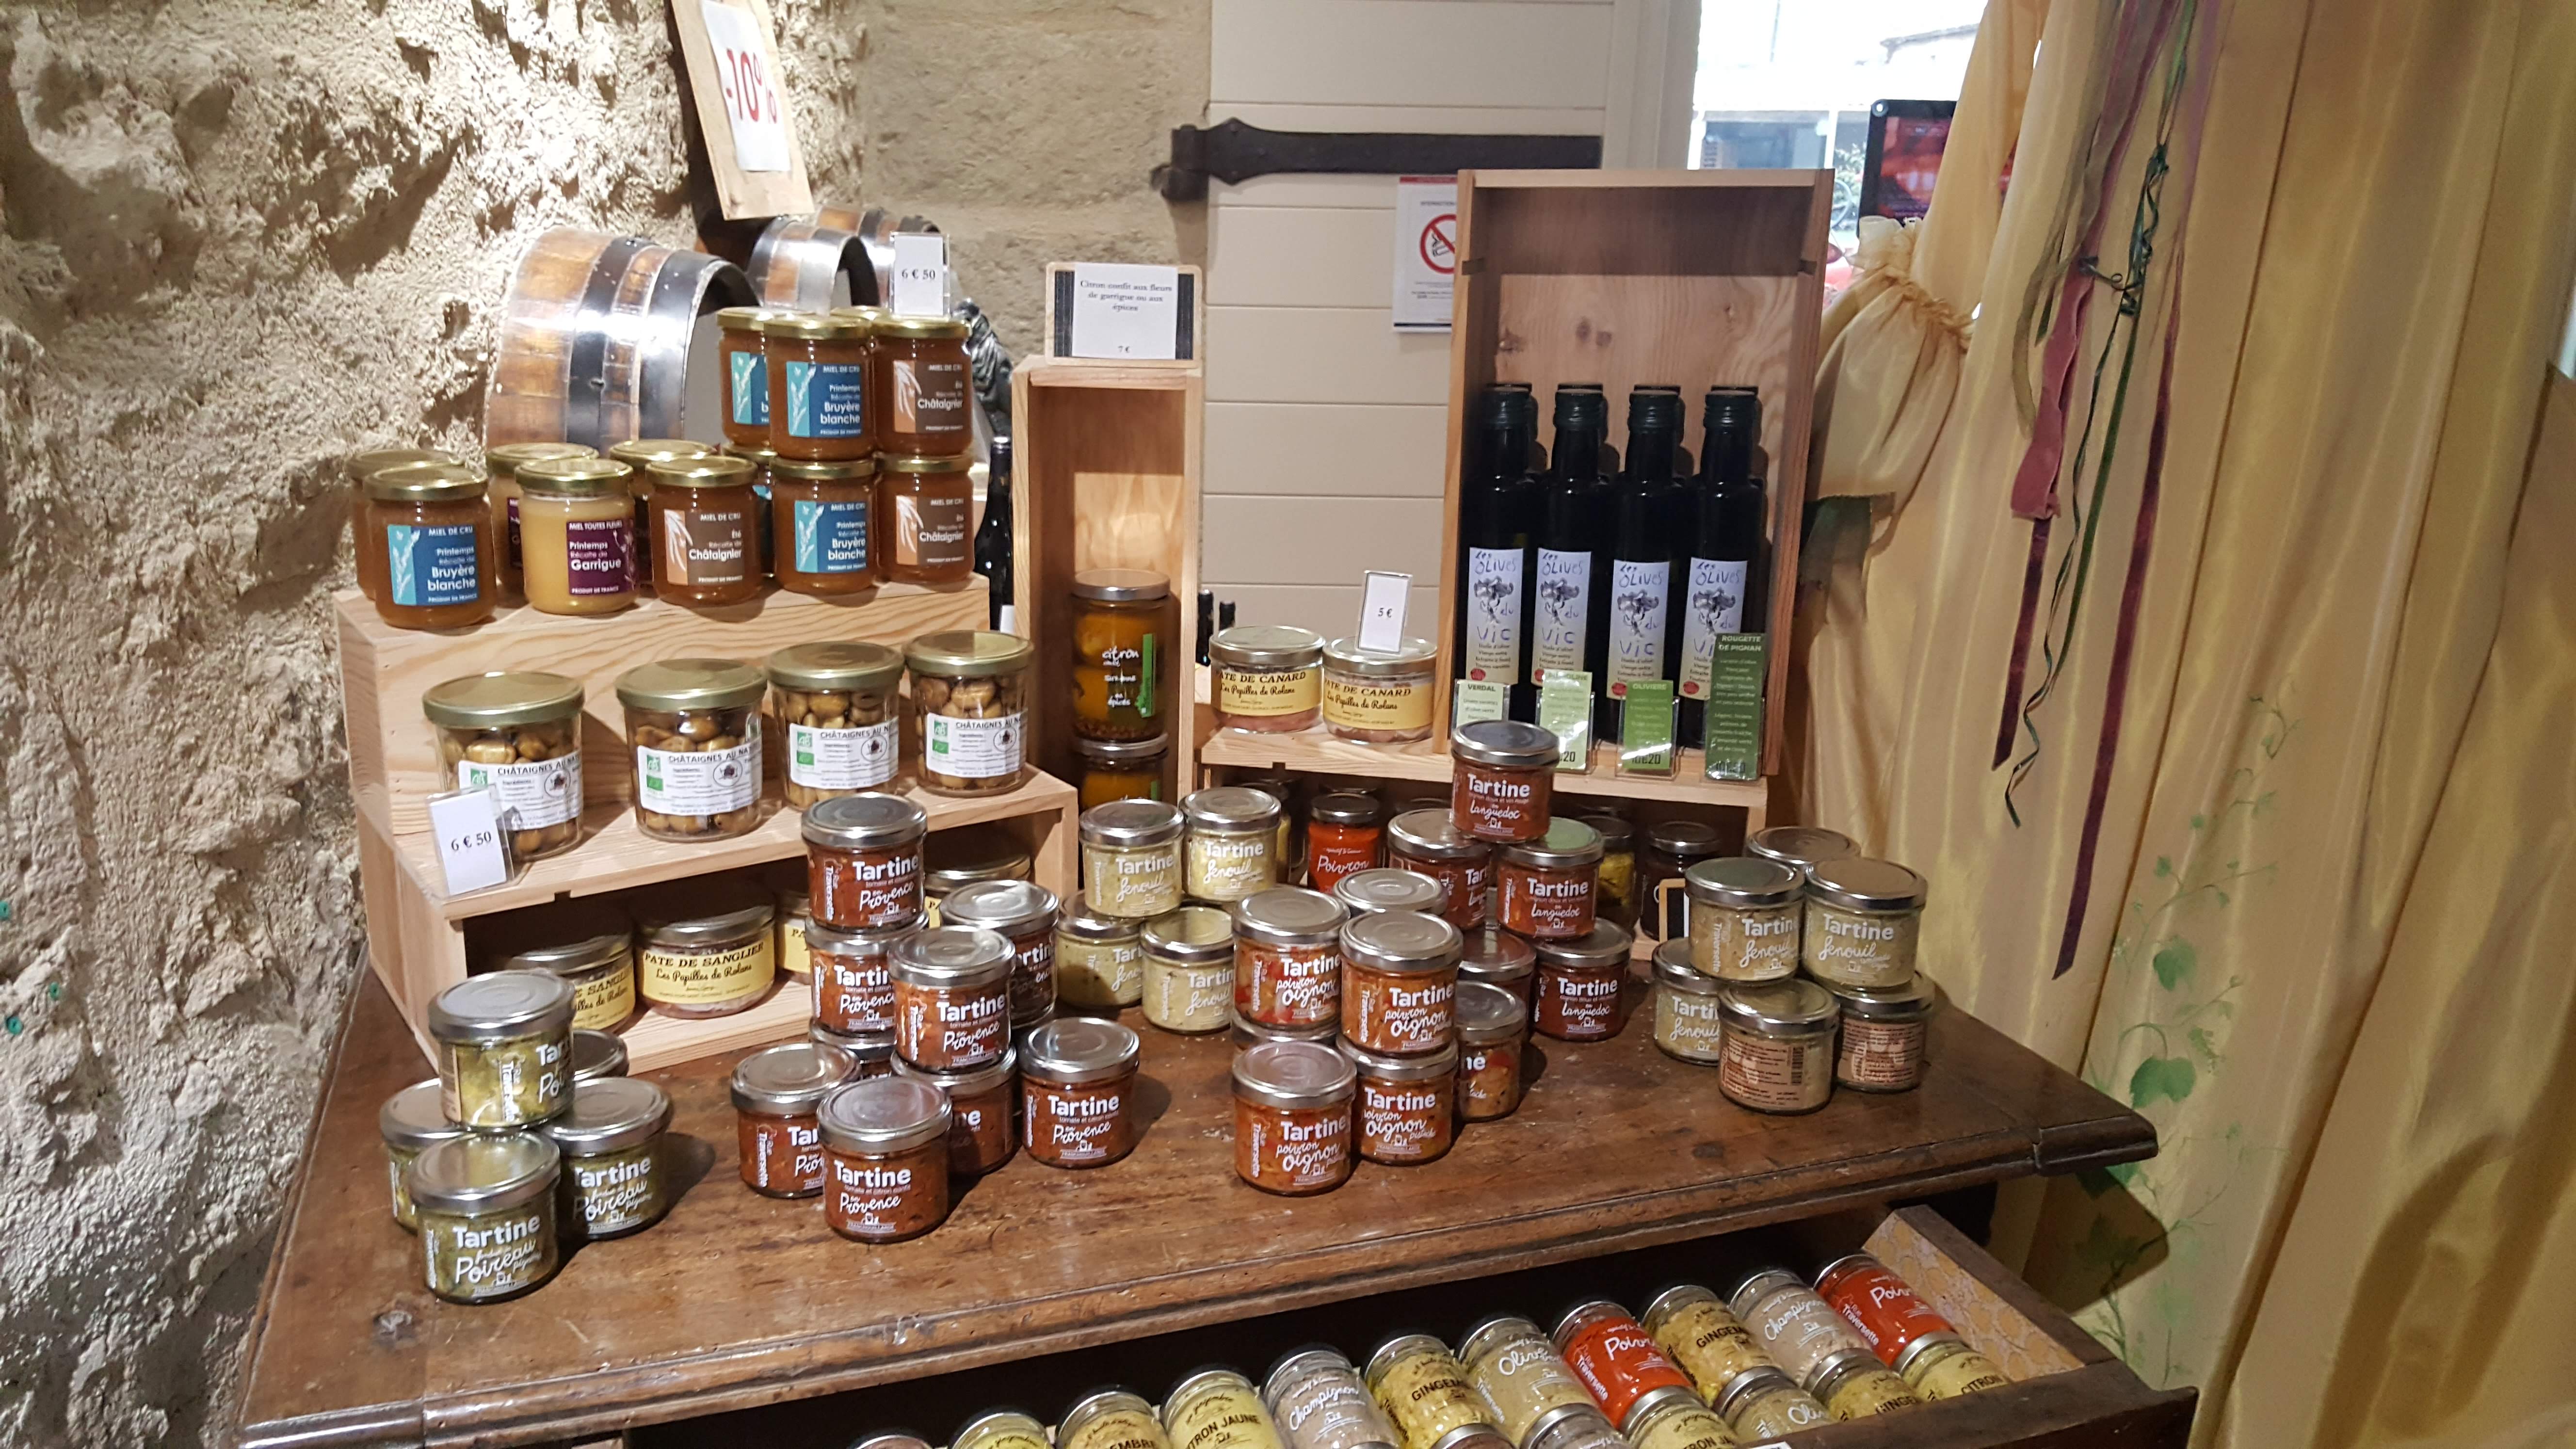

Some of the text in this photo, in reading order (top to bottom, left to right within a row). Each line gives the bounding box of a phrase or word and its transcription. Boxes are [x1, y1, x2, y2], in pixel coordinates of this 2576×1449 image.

[725, 48, 777, 125] -10%
[902, 269, 936, 280] 6 € 50
[1080, 280, 1105, 289] Citron
[1100, 293, 1133, 302] garrigue
[1112, 303, 1138, 312] épices
[829, 385, 860, 393] Printemps
[824, 402, 860, 414] Bruyère
[918, 399, 963, 410] Châtaignier
[820, 413, 860, 424] blanche
[429, 528, 446, 536] MIEL
[569, 522, 583, 531] MIEL
[584, 522, 605, 530] TOUTES
[569, 541, 608, 550] Printemps
[832, 537, 866, 549] Bruyère
[920, 531, 964, 543] Châtaignier
[436, 547, 475, 556] Printemps
[689, 548, 741, 561] Châtaignier
[828, 549, 866, 561] blanche
[432, 565, 475, 580] Bruyère
[571, 559, 621, 572] Garrigue
[428, 578, 476, 592] blanche
[1378, 608, 1393, 618] 5 €
[1240, 674, 1255, 683] DE
[1259, 671, 1306, 684] CANARD
[1260, 686, 1268, 695] de
[1343, 685, 1357, 694] DE
[1361, 688, 1411, 697] CANARD
[1361, 698, 1369, 708] de
[956, 720, 1003, 729] CHÂTAIGNES
[821, 729, 870, 739] CHÂTAIGNES
[669, 751, 737, 763] CHÂTAIGNES AU
[498, 764, 552, 776] CHÂTAIGNES
[1467, 774, 1530, 797] Tartine
[1470, 800, 1519, 820] Languedoc
[451, 831, 491, 851] 6 € 50
[1205, 840, 1264, 857] Tartine
[853, 857, 918, 881] Tartine
[1117, 855, 1173, 874] Tartine
[1318, 856, 1368, 873] Poivron
[860, 881, 914, 911] Provence
[1528, 878, 1588, 898] Tartine
[1531, 903, 1579, 920] Languedoc
[1742, 918, 1792, 936] Tartin
[1822, 914, 1894, 941] Tartine
[645, 944, 764, 967] PATE DE SANGLIER
[1713, 923, 1722, 972] Traversette
[656, 969, 670, 982] Les
[673, 968, 708, 985] Papilles
[712, 967, 722, 978] de
[1276, 976, 1317, 992] poivron
[1283, 980, 1336, 1007] Oignon
[1390, 984, 1454, 1007] Tartine
[1558, 978, 1618, 996] Tartine
[937, 995, 1005, 1021] Tartine
[1361, 990, 1369, 1043] Traversette
[1385, 1007, 1427, 1022] poivron
[1562, 1002, 1610, 1018] Languedoc
[1391, 1010, 1446, 1037] Oignon
[944, 1022, 998, 1052] Provence
[1048, 1096, 1119, 1116] Tartine
[1364, 1087, 1435, 1111] Tartine
[1053, 1122, 1111, 1145] Provence
[1281, 1117, 1346, 1141] Tartine
[1365, 1119, 1426, 1142] Oignon
[1276, 1140, 1319, 1156] poivron
[1283, 1143, 1339, 1172] Oignon
[834, 1161, 911, 1187] Tartine
[840, 1192, 901, 1213] Provence
[453, 1216, 540, 1248] Tartine
[454, 1239, 535, 1284] Poireau
[1843, 1304, 1879, 1345] Traversette
[1577, 1357, 1608, 1401] Traversette
[1221, 1414, 1261, 1428] JAUNE
